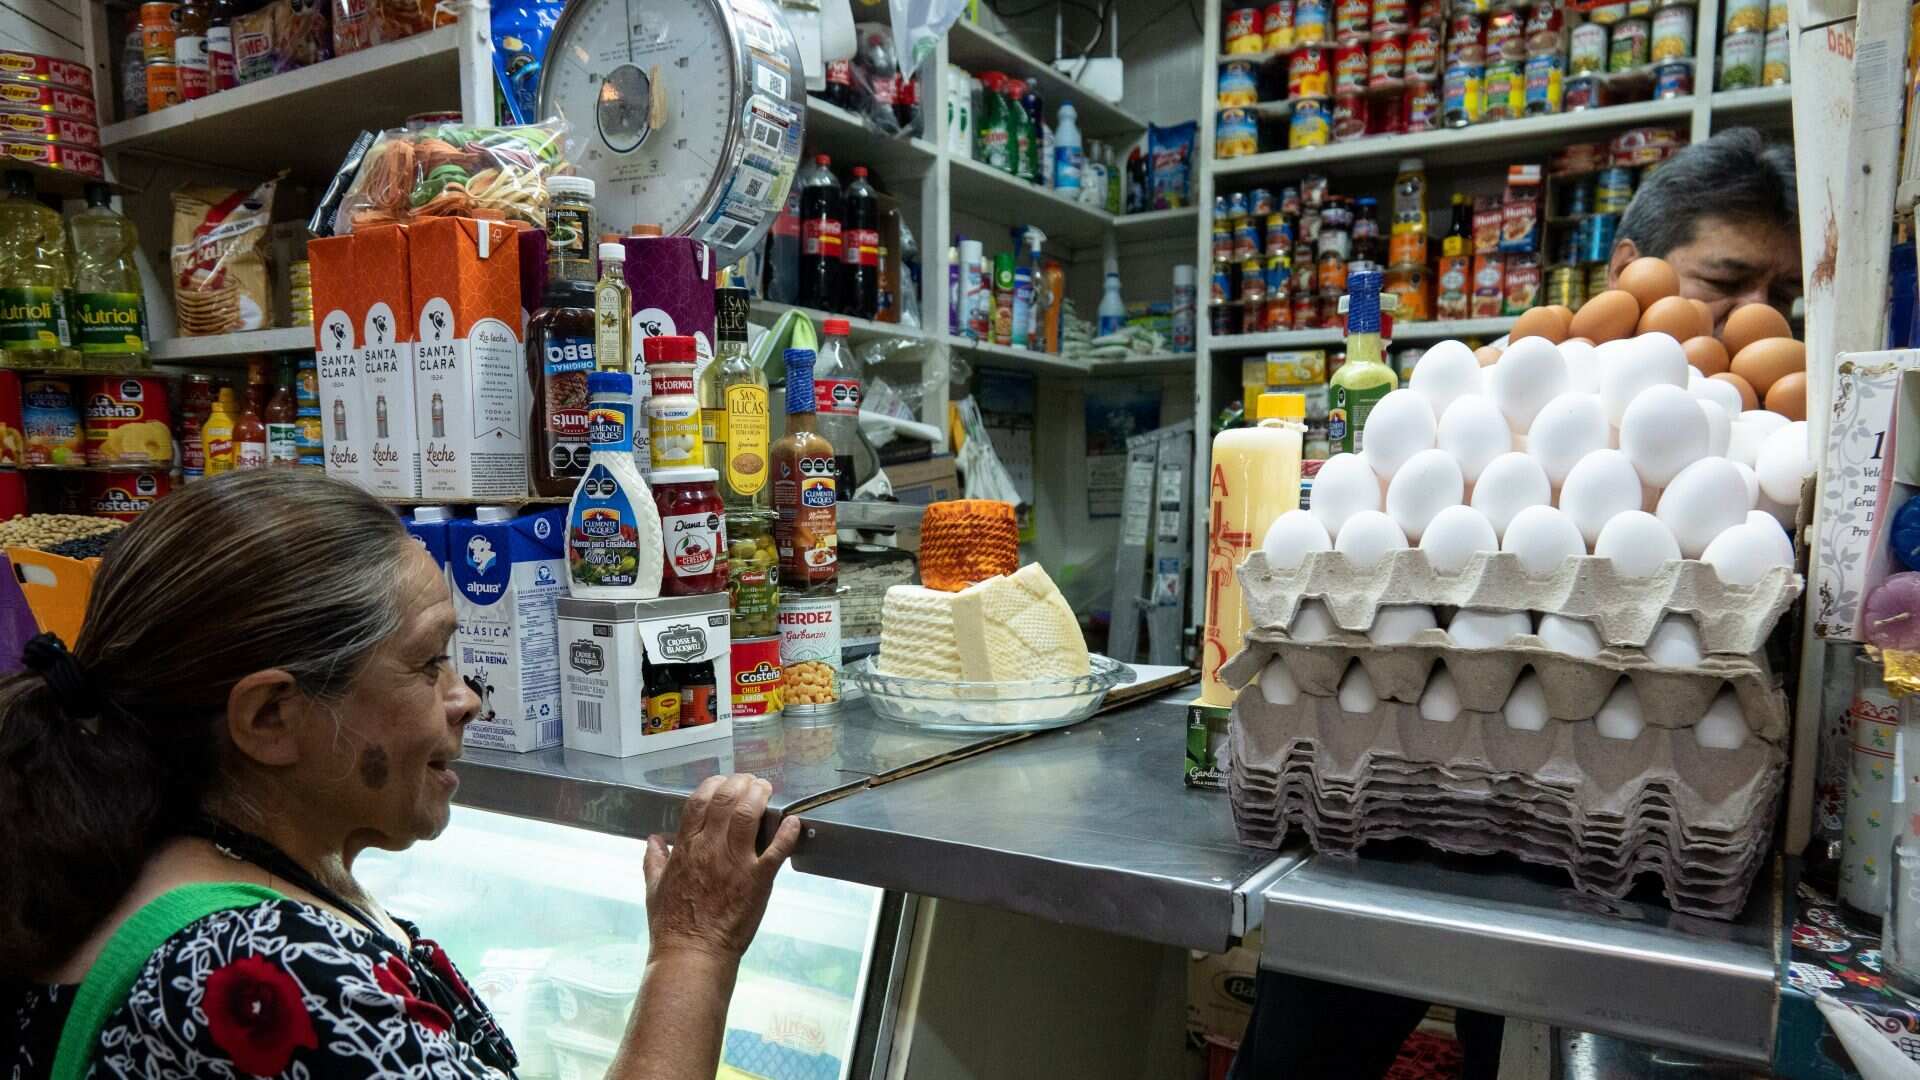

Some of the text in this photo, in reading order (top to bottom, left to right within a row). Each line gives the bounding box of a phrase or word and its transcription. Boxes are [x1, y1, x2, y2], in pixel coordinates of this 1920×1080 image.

[3, 302, 51, 320] utrioli
[365, 350, 397, 360] SANTA
[420, 346, 455, 358] SANTA
[321, 355, 356, 366] SANTA
[420, 359, 455, 371] CLARA
[551, 360, 594, 371] ORIGINAL
[321, 367, 356, 378] CLARA
[365, 361, 398, 373] CLARA
[740, 389, 756, 400] SAN
[95, 397, 109, 406] La
[732, 399, 764, 415] LUCAS
[87, 405, 136, 417] osteña
[633, 430, 650, 450] Lec
[330, 444, 359, 468] Leche
[372, 442, 399, 467] Leche
[427, 440, 456, 468] Leche
[109, 491, 124, 501] La
[96, 498, 150, 511] osteña
[584, 520, 617, 528] CLEMENTE
[674, 519, 702, 532] Diana
[587, 526, 615, 535] JACQUES
[1851, 526, 1871, 537] Pro
[605, 539, 637, 548] Ensaladas
[682, 552, 707, 565] CEREZAS
[467, 581, 499, 596] alpura
[777, 610, 832, 625] HERDEZ
[459, 624, 509, 637] CLÁSICA
[786, 629, 826, 641] Garbanzos
[667, 637, 691, 646] CROSSE
[666, 643, 701, 654] BLACKWELL
[475, 655, 508, 665] LA REINA
[574, 656, 599, 665] BLACKWELL
[759, 664, 769, 672] La
[741, 669, 780, 683] Costeña
[742, 686, 761, 694] CHILES
